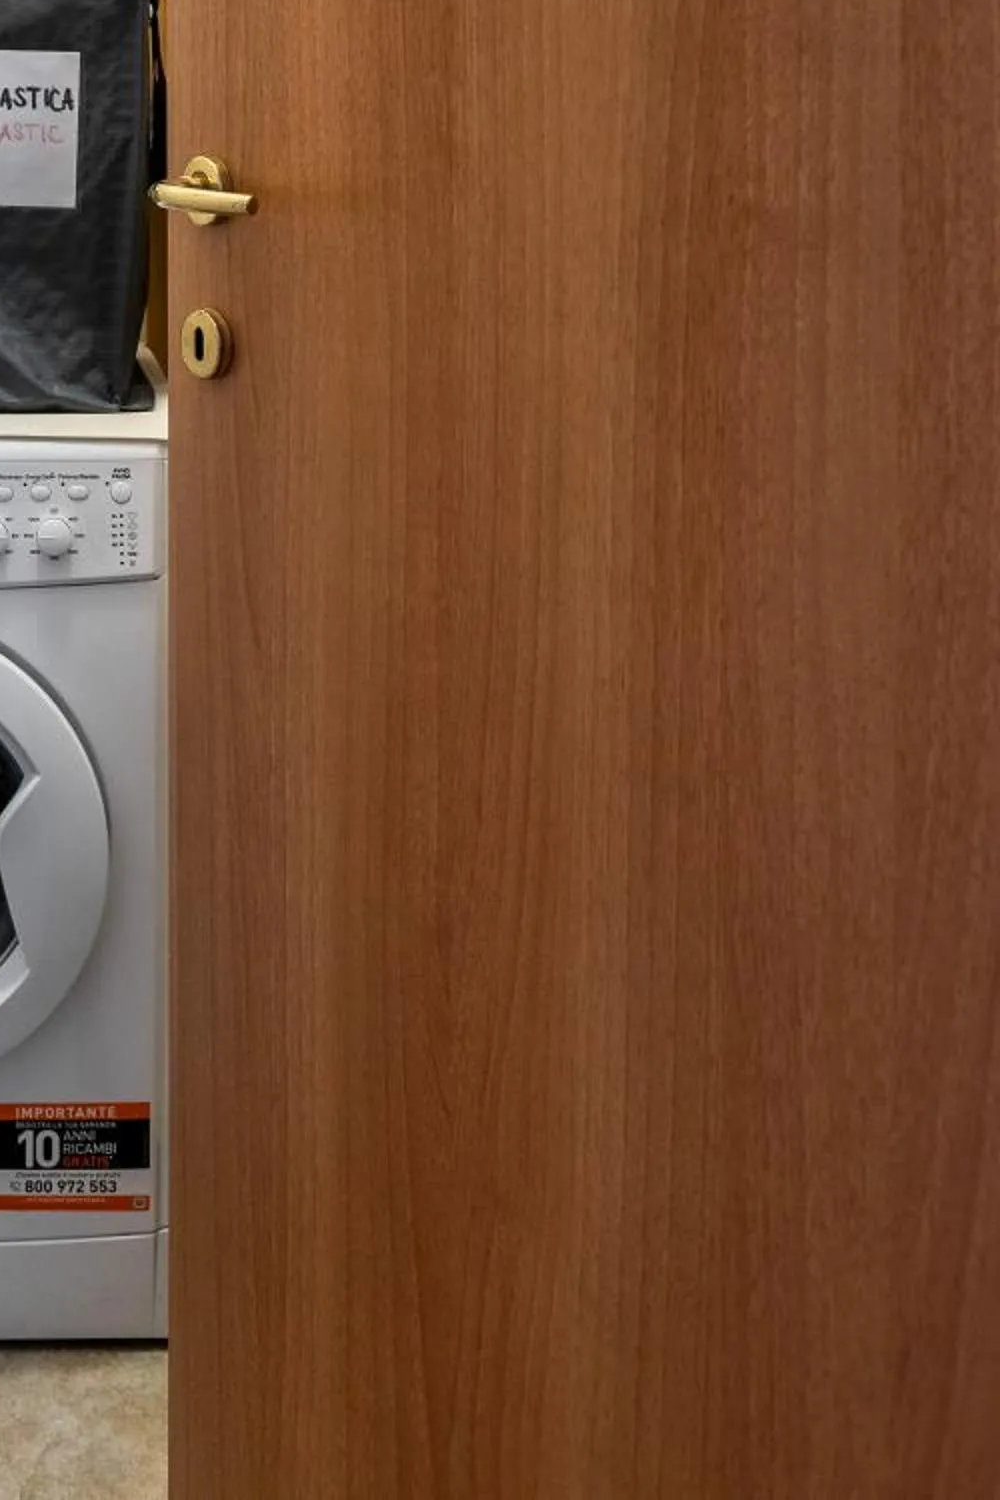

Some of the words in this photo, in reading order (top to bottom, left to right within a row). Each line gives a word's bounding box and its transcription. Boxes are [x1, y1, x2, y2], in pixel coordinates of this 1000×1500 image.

[15, 1106, 118, 1120] IMPORTANTE
[63, 1131, 97, 1141] ANNI
[17, 1129, 61, 1169] 10
[63, 1142, 117, 1155] RICAMBI
[25, 1180, 53, 1193] 800
[57, 1180, 85, 1193] 972
[89, 1180, 118, 1193] 553
